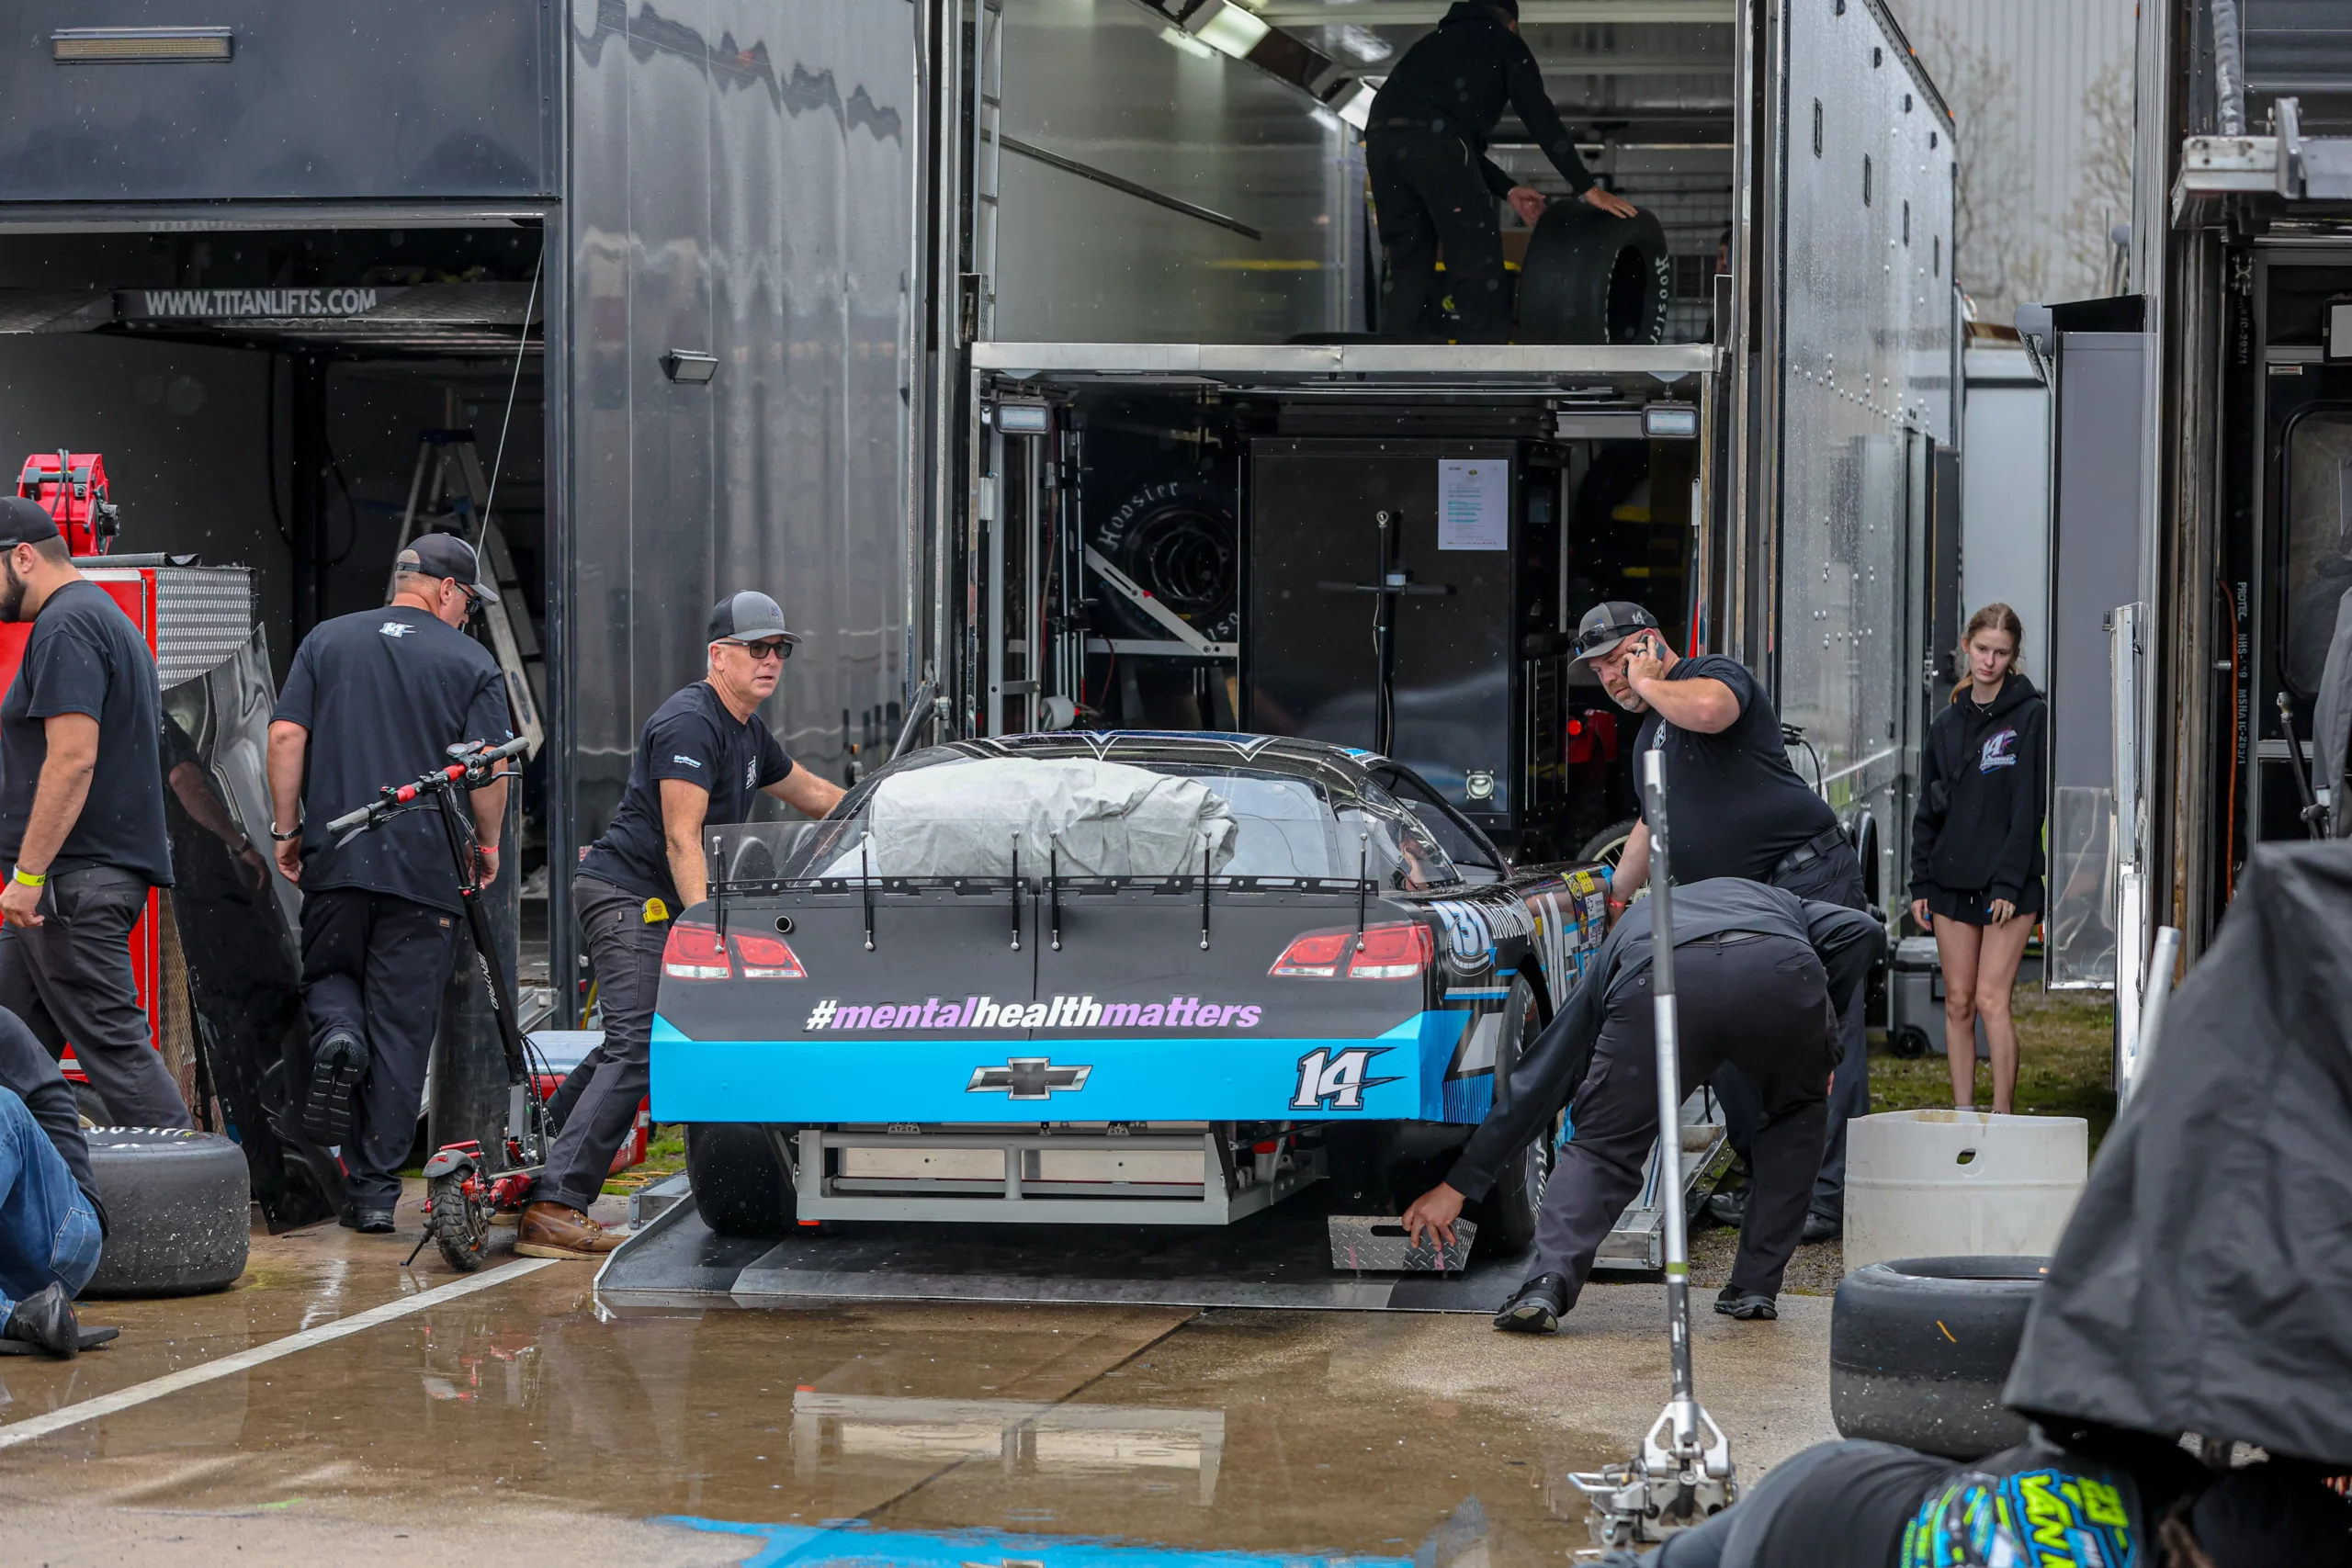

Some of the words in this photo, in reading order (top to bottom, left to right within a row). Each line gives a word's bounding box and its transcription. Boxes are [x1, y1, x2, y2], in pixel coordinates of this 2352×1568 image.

[145, 288, 377, 316] WWW.TITANLIFTS.COM
[1098, 481, 1179, 551] Hoosier
[805, 995, 1262, 1031] #mentalhealthmatters
[1288, 1046, 1401, 1111] 14
